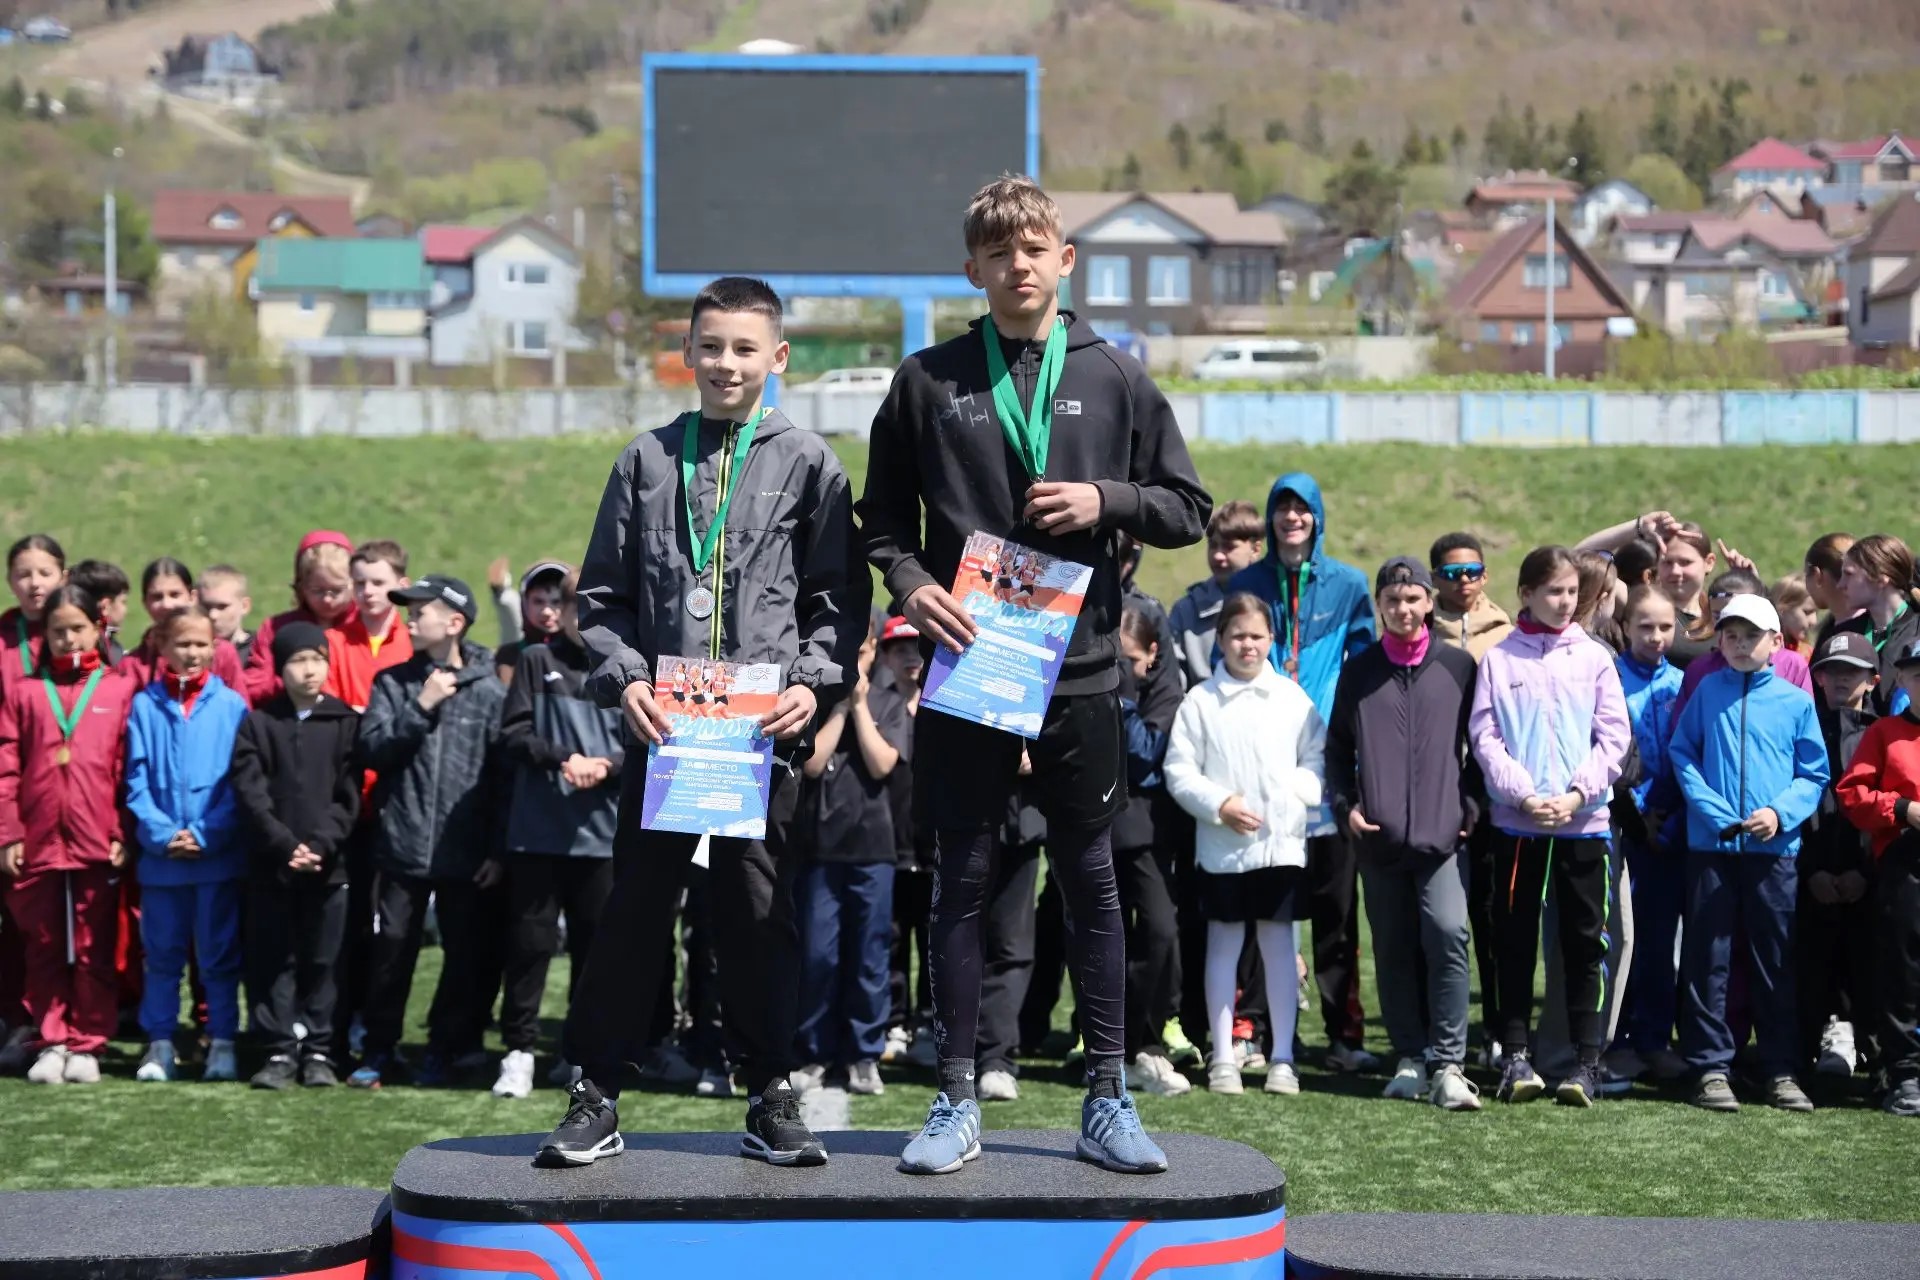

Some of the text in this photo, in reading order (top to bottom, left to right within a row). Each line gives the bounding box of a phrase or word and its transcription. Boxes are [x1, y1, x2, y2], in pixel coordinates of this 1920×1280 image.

[996, 647, 1029, 662] МЕСТО
[681, 761, 738, 772] ЗА МЕСТО
